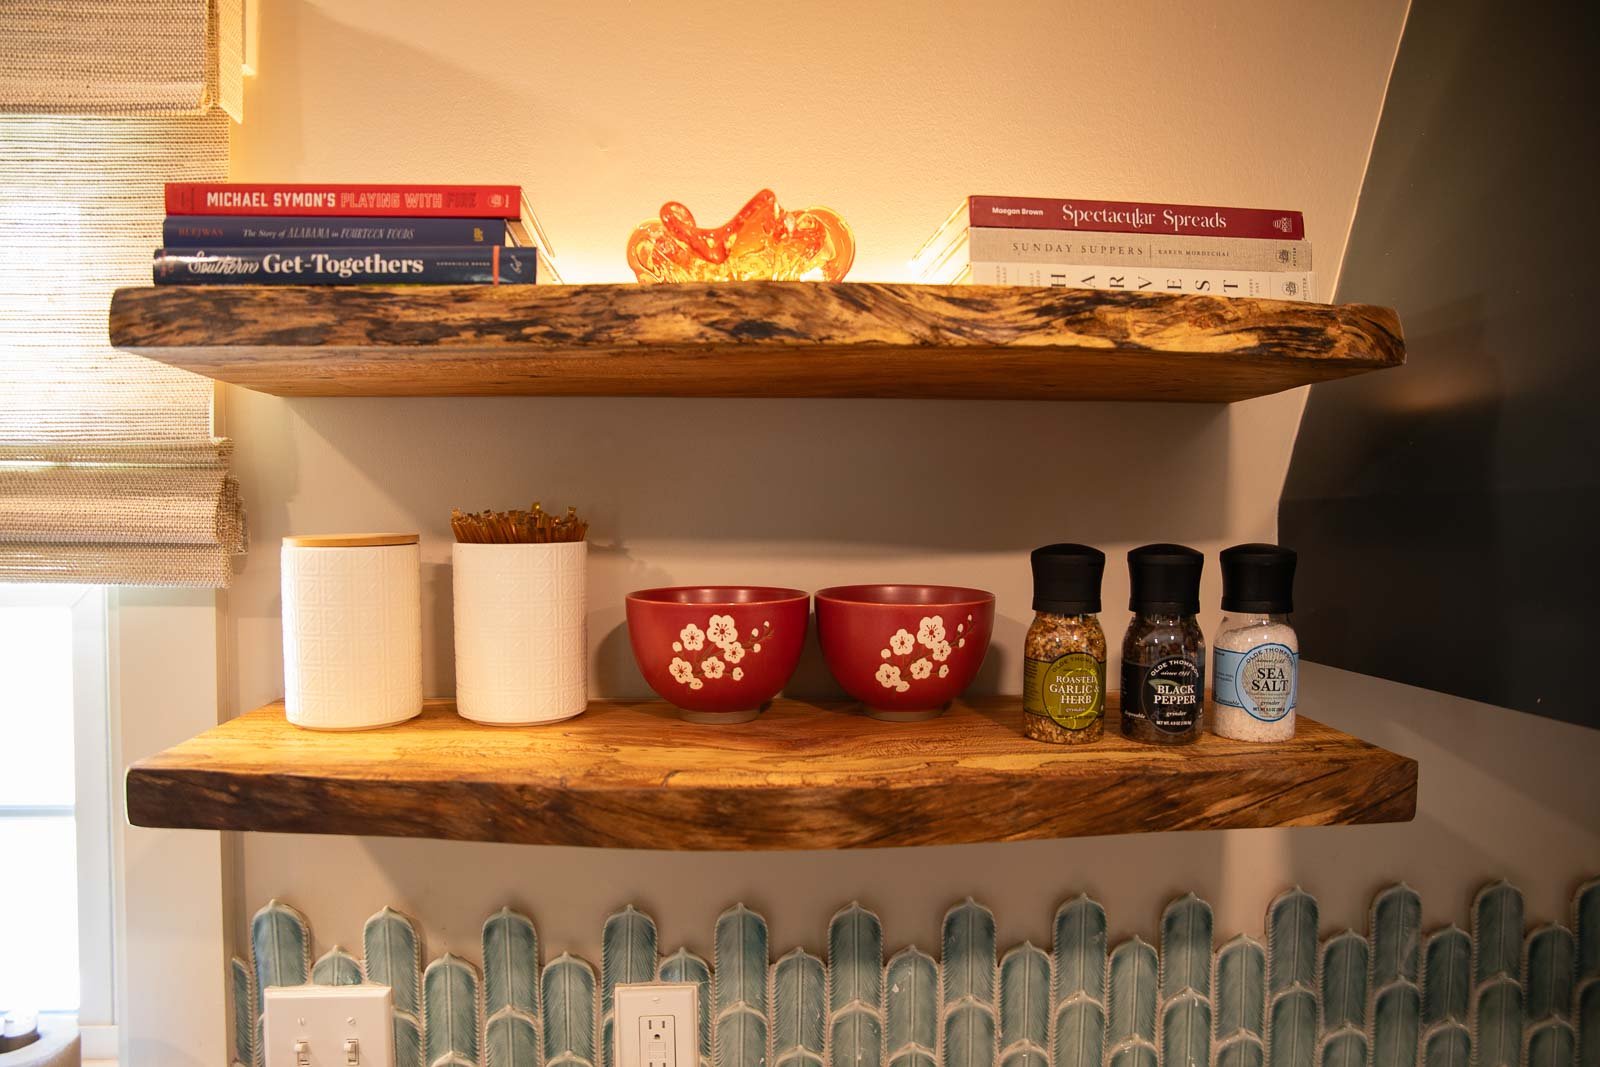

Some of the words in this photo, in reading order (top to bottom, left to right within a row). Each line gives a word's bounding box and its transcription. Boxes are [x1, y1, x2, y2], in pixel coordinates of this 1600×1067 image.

[206, 192, 269, 208] MICHAEL
[273, 192, 337, 208] SYMON'S
[341, 192, 401, 209] PLAYING
[404, 193, 443, 209] WITH
[992, 207, 1020, 217] Maegan
[1021, 208, 1044, 216] Brown
[1062, 204, 1156, 228] Spectacular
[1163, 209, 1227, 231] Spreads
[243, 229, 256, 238] The
[258, 229, 277, 240] Story
[279, 227, 286, 238] of
[287, 227, 331, 238] ALABAMA
[340, 228, 384, 239] FOURTEEN
[387, 229, 415, 240] FOODS
[1013, 242, 1073, 253] SUNDAY
[1081, 244, 1144, 255] SUPPERS
[188, 251, 259, 275] Southern
[262, 253, 424, 278] Get-Togethers
[1246, 649, 1263, 664] OLDE
[1150, 662, 1168, 677] OLDE
[1257, 667, 1285, 680] SEA
[1056, 675, 1097, 684] ROASTED
[1251, 679, 1289, 692] SALT
[1049, 683, 1093, 694] GARLIC
[1157, 684, 1195, 695] BLACK
[1060, 695, 1092, 704] HERB
[1153, 694, 1196, 705] PEPPER
[1166, 710, 1187, 718] grinder
